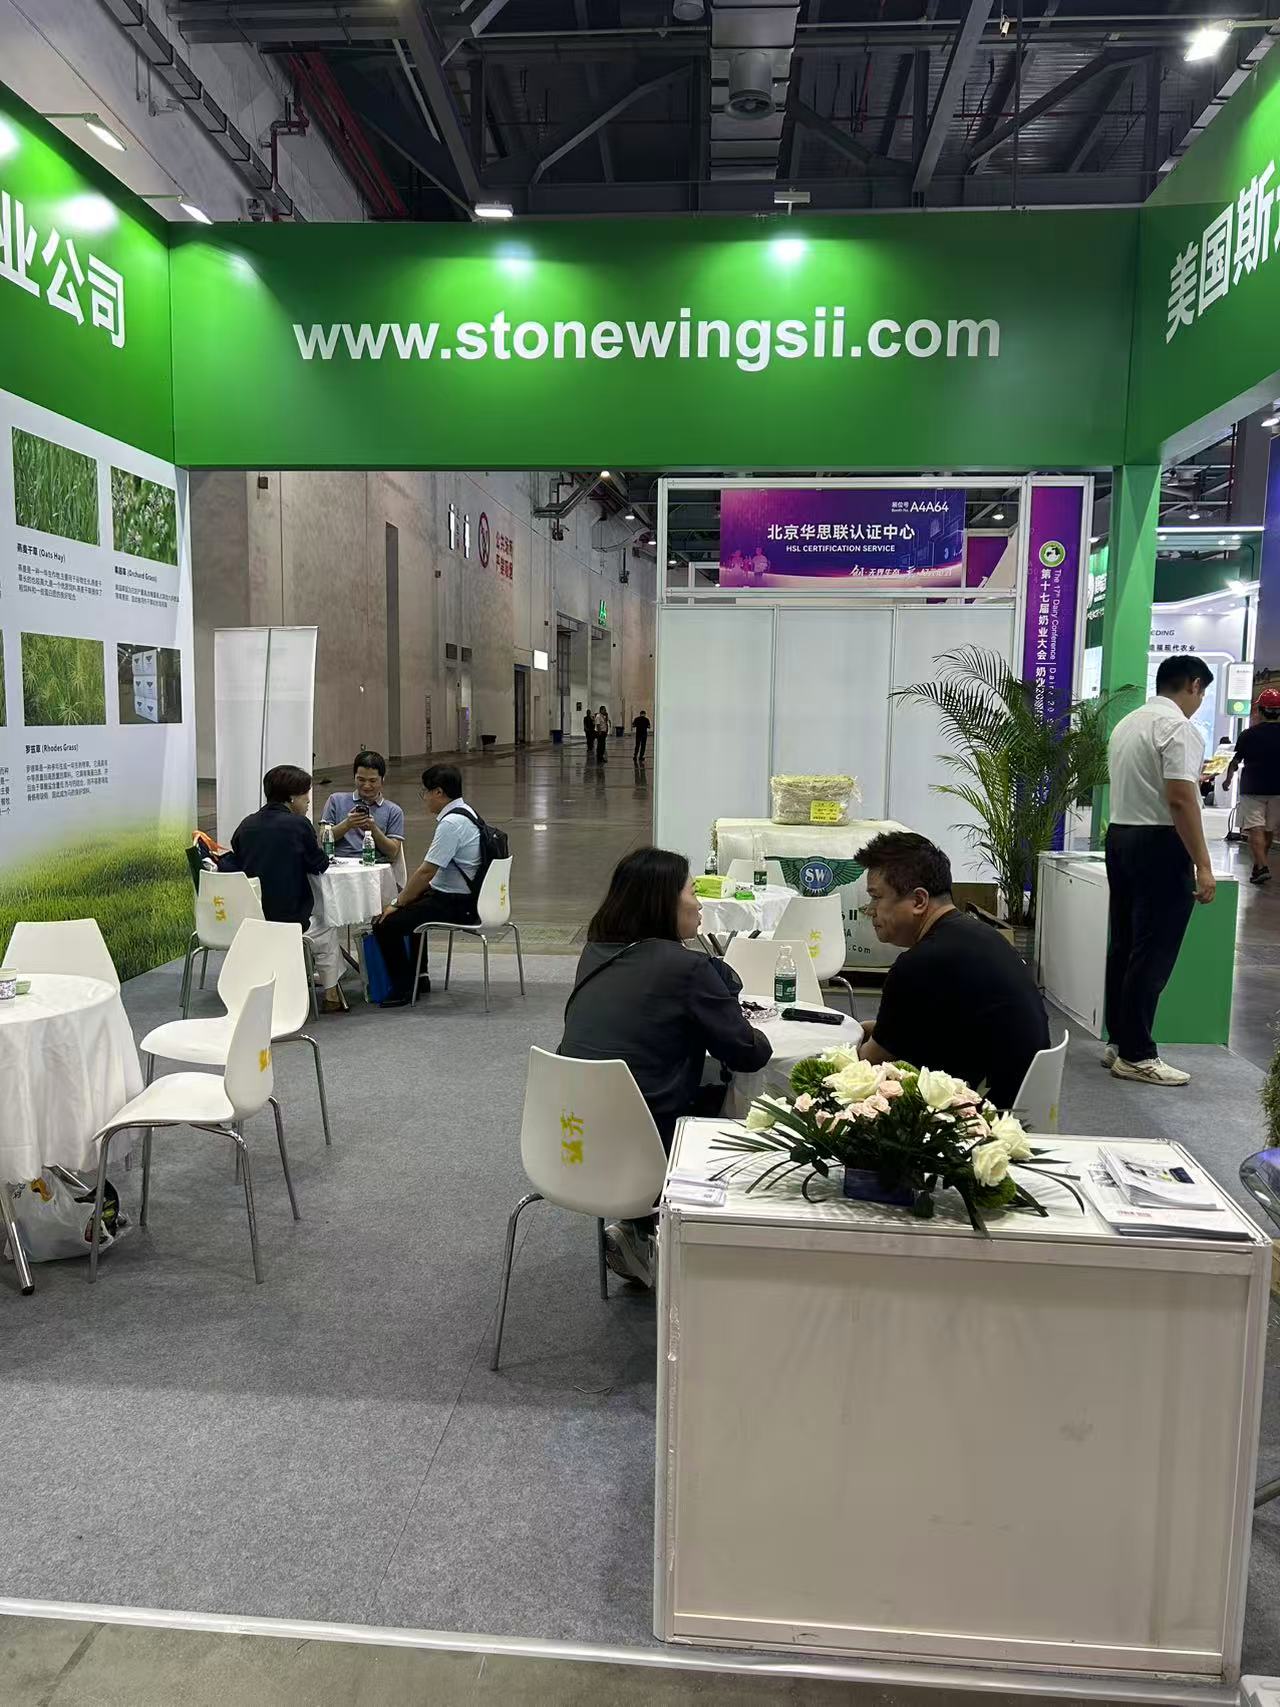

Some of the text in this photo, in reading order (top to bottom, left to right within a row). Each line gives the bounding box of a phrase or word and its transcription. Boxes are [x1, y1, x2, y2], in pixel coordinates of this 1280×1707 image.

[1165, 159, 1280, 344] 美国斯
[292, 306, 1001, 373] www.stonewingsii.com
[910, 501, 949, 513] A4A64
[767, 523, 916, 541] 北京华思联认证中心
[786, 544, 896, 553] HSL CERTIFICATION SERVICE
[1053, 569, 1062, 584] The
[1036, 568, 1051, 660] 第十七届奶业大会
[1051, 599, 1061, 618] Dairy
[1050, 618, 1060, 660] Conference
[804, 868, 827, 883] SW
